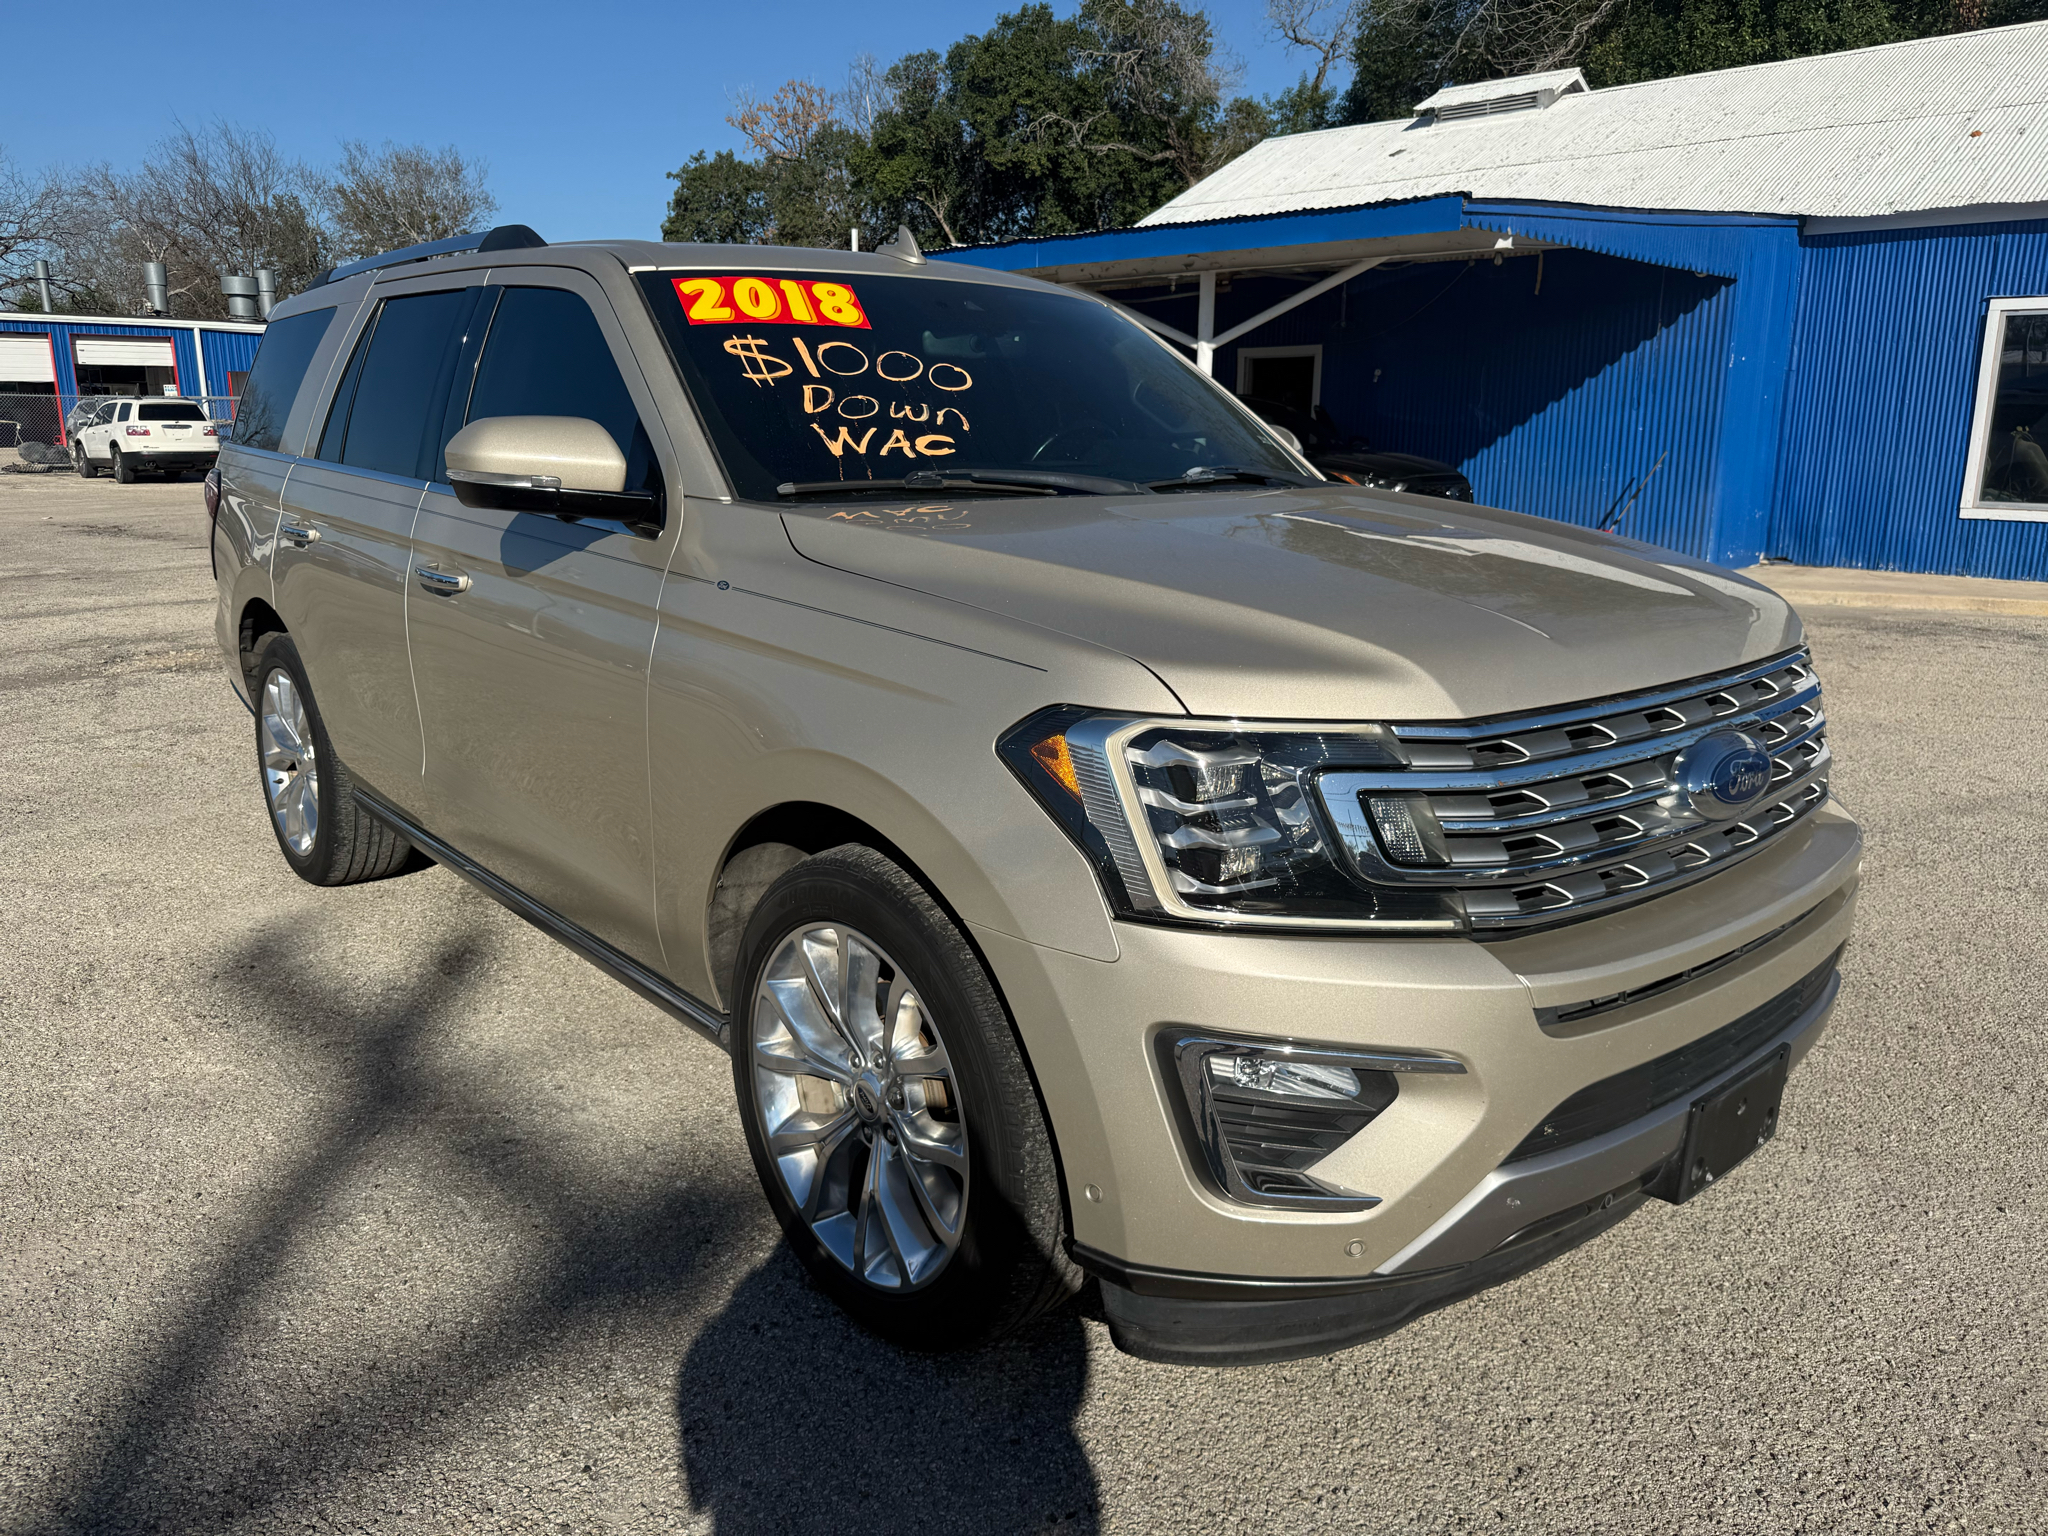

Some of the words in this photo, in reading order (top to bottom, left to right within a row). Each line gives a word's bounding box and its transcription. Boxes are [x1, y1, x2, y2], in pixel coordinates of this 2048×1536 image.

[679, 278, 864, 325] 2018
[723, 334, 973, 391] $1000
[810, 423, 956, 459] WAC
[1729, 757, 1764, 795] Ford
